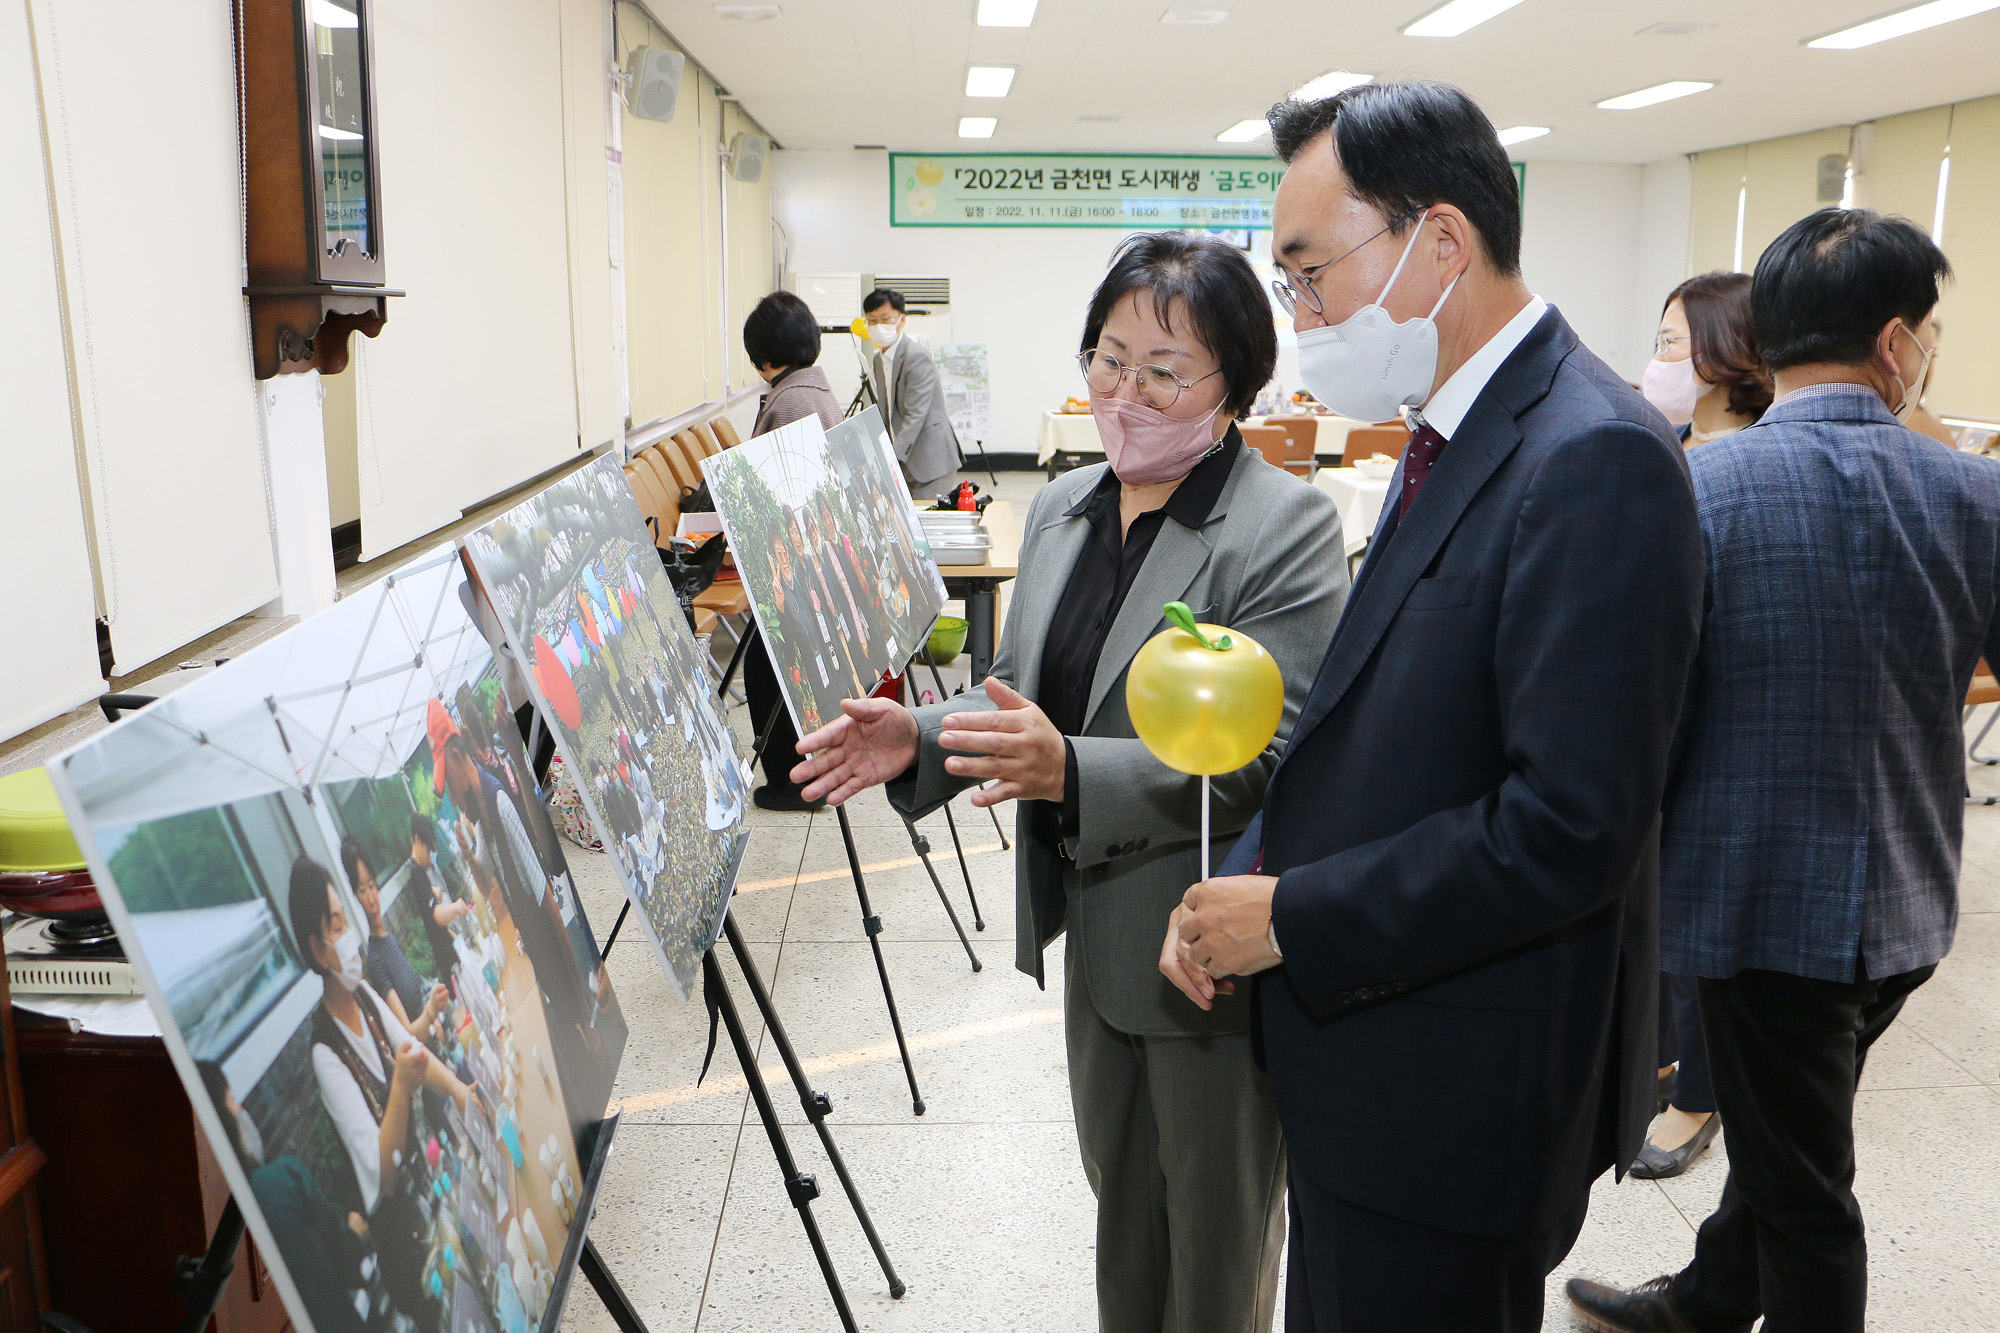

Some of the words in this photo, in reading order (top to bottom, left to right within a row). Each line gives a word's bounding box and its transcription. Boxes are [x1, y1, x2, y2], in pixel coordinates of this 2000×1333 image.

[1050, 168, 1111, 190] 금천면
[1118, 169, 1200, 192] 도시재생
[965, 206, 985, 217] 일정
[1087, 206, 1115, 217] 16:00
[1131, 206, 1159, 217] 18:00
[1180, 207, 1200, 218] 장소
